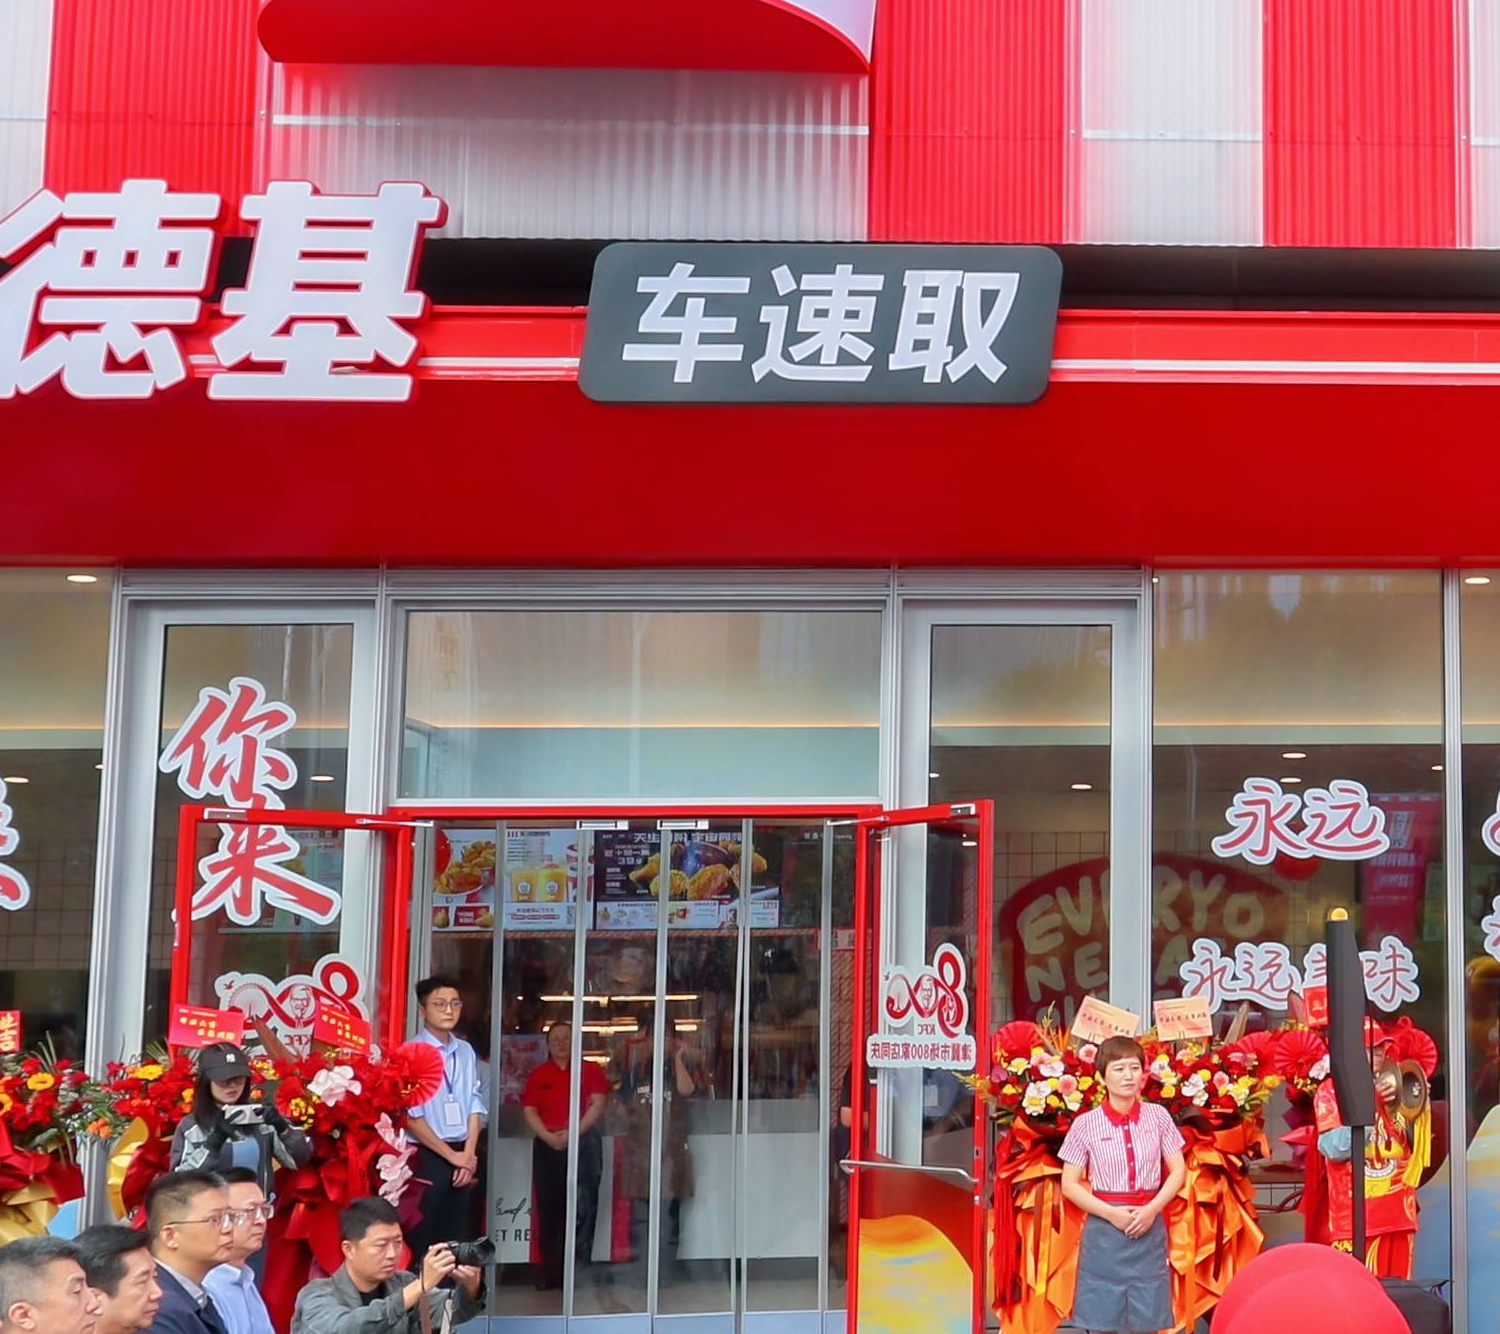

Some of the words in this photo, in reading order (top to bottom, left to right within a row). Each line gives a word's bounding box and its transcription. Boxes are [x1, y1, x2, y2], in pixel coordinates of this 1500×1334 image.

[620, 263, 1020, 386] 车速取
[167, 683, 336, 917] 你来
[1219, 785, 1384, 857] 永远
